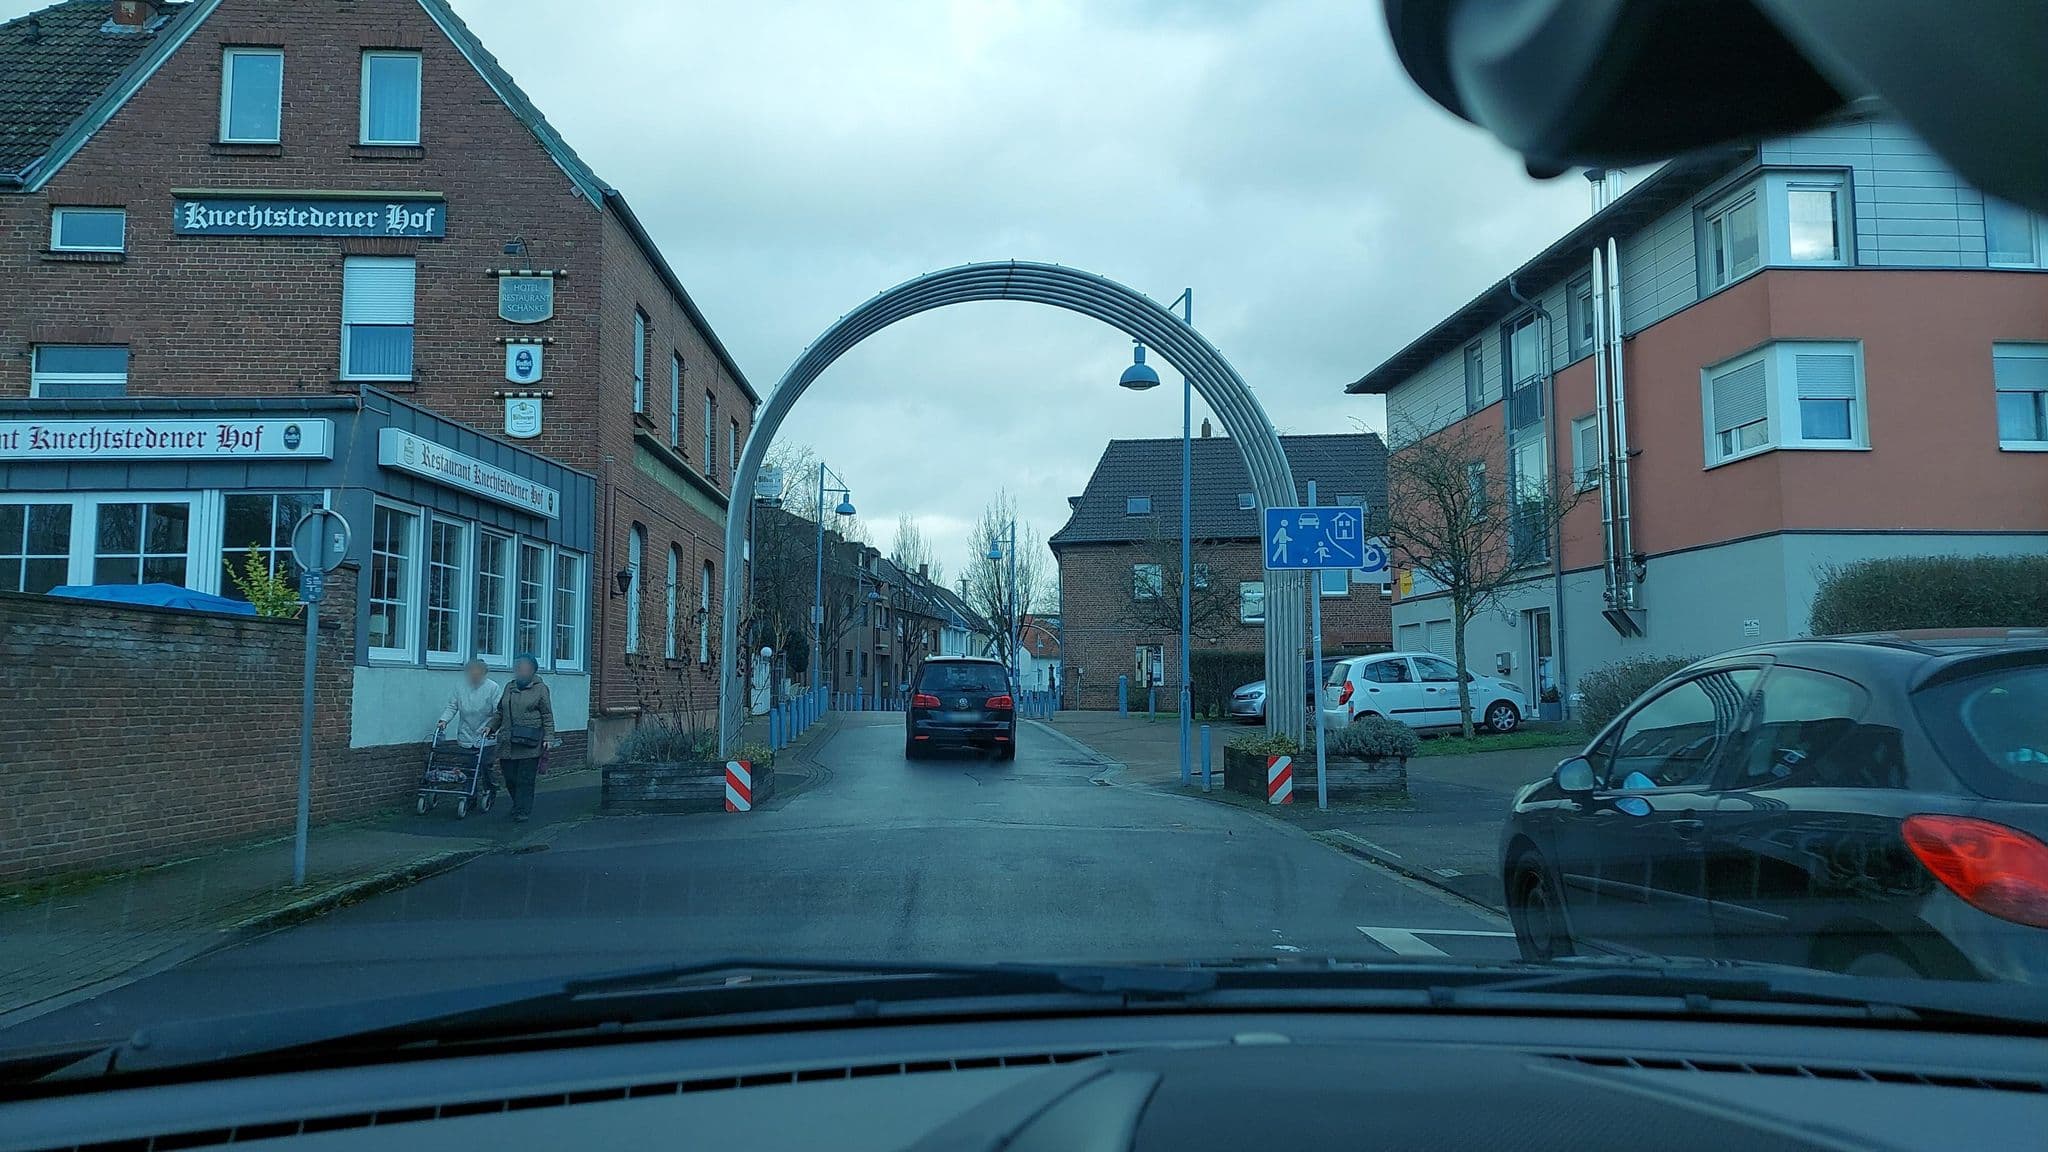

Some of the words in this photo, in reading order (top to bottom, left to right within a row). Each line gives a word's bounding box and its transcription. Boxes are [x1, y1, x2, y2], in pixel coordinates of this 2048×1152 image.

[184, 202, 379, 229] Knechtstedener
[386, 204, 436, 234] Hof
[503, 293, 550, 302] RESTAURANT
[514, 284, 538, 292] HOTEL
[28, 425, 207, 453] Knechtstedener
[216, 424, 264, 452] Hof
[421, 443, 471, 481] Restaurant
[473, 464, 528, 501] Knechtstedener
[530, 484, 544, 510] Hof
